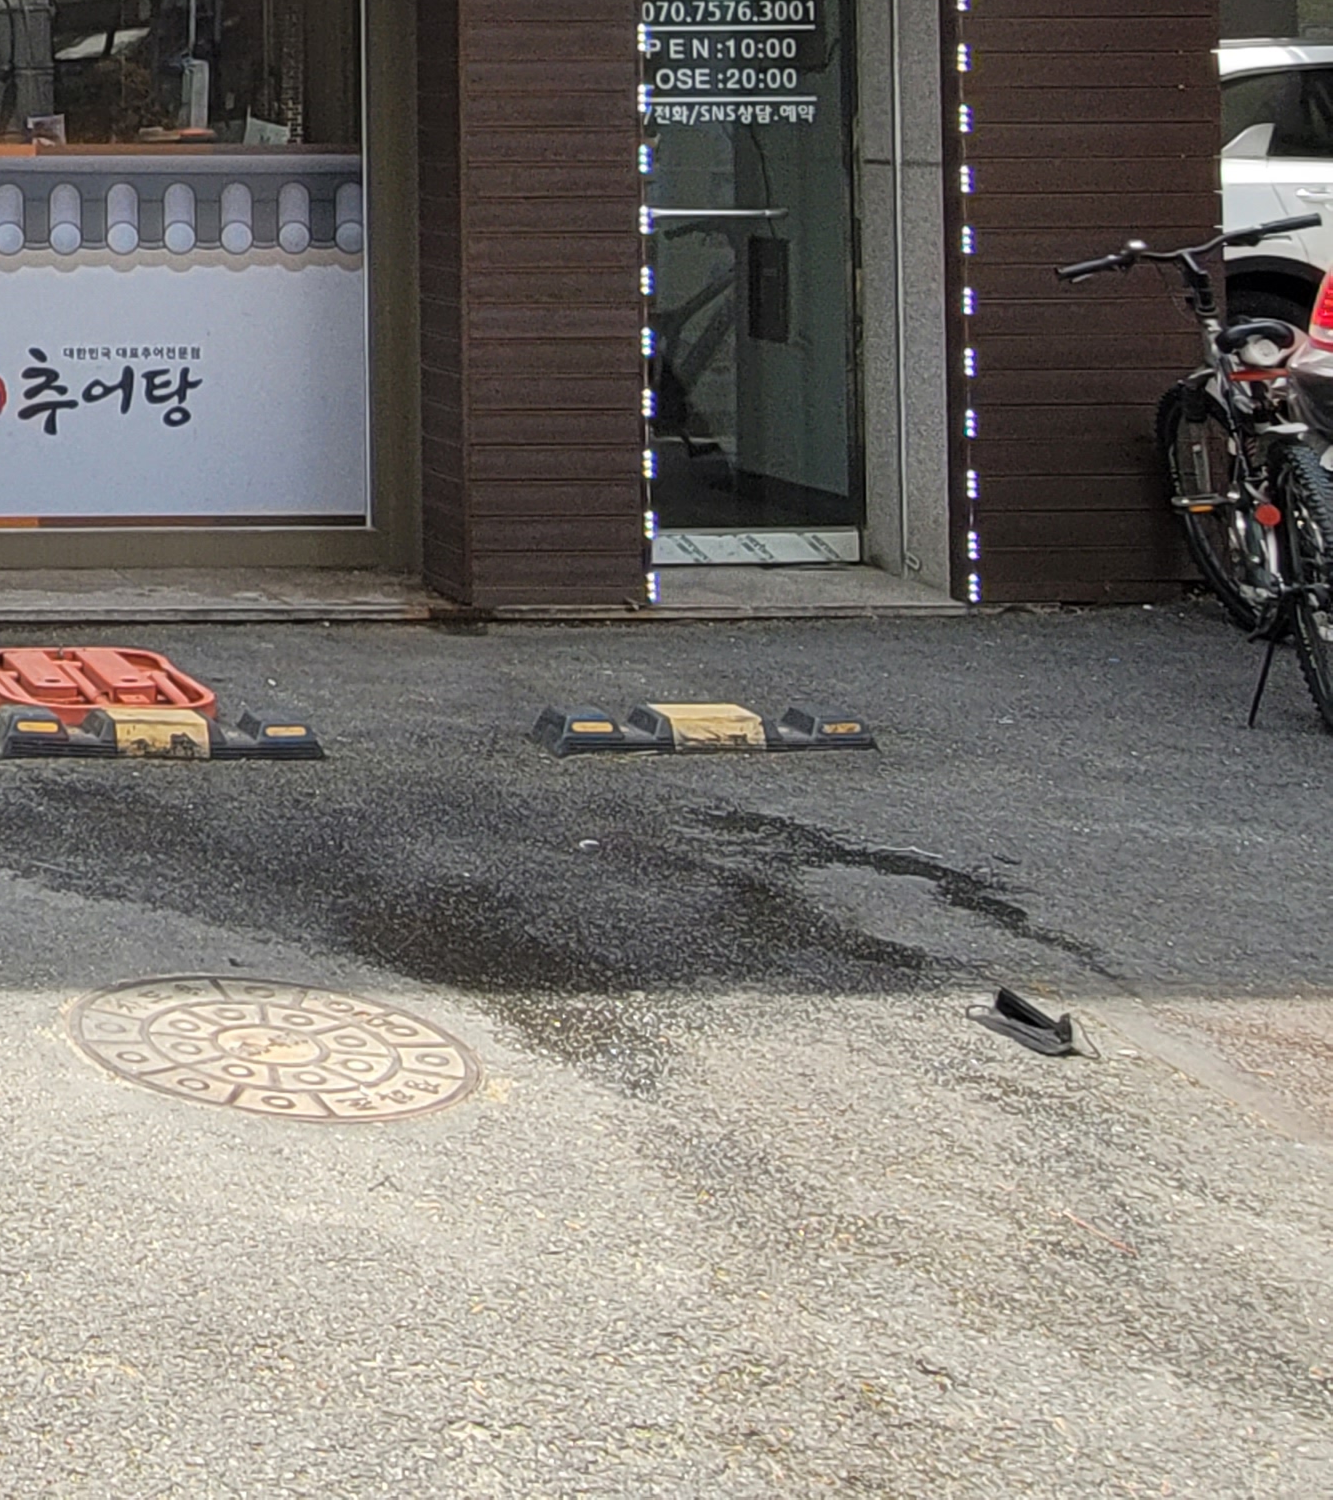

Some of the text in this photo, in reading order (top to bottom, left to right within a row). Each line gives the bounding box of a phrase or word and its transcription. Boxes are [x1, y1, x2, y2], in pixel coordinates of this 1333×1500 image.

[642, 1, 815, 22] 070.7576.3001
[63, 347, 111, 360] 대한민국
[17, 347, 203, 436] 추어탕
